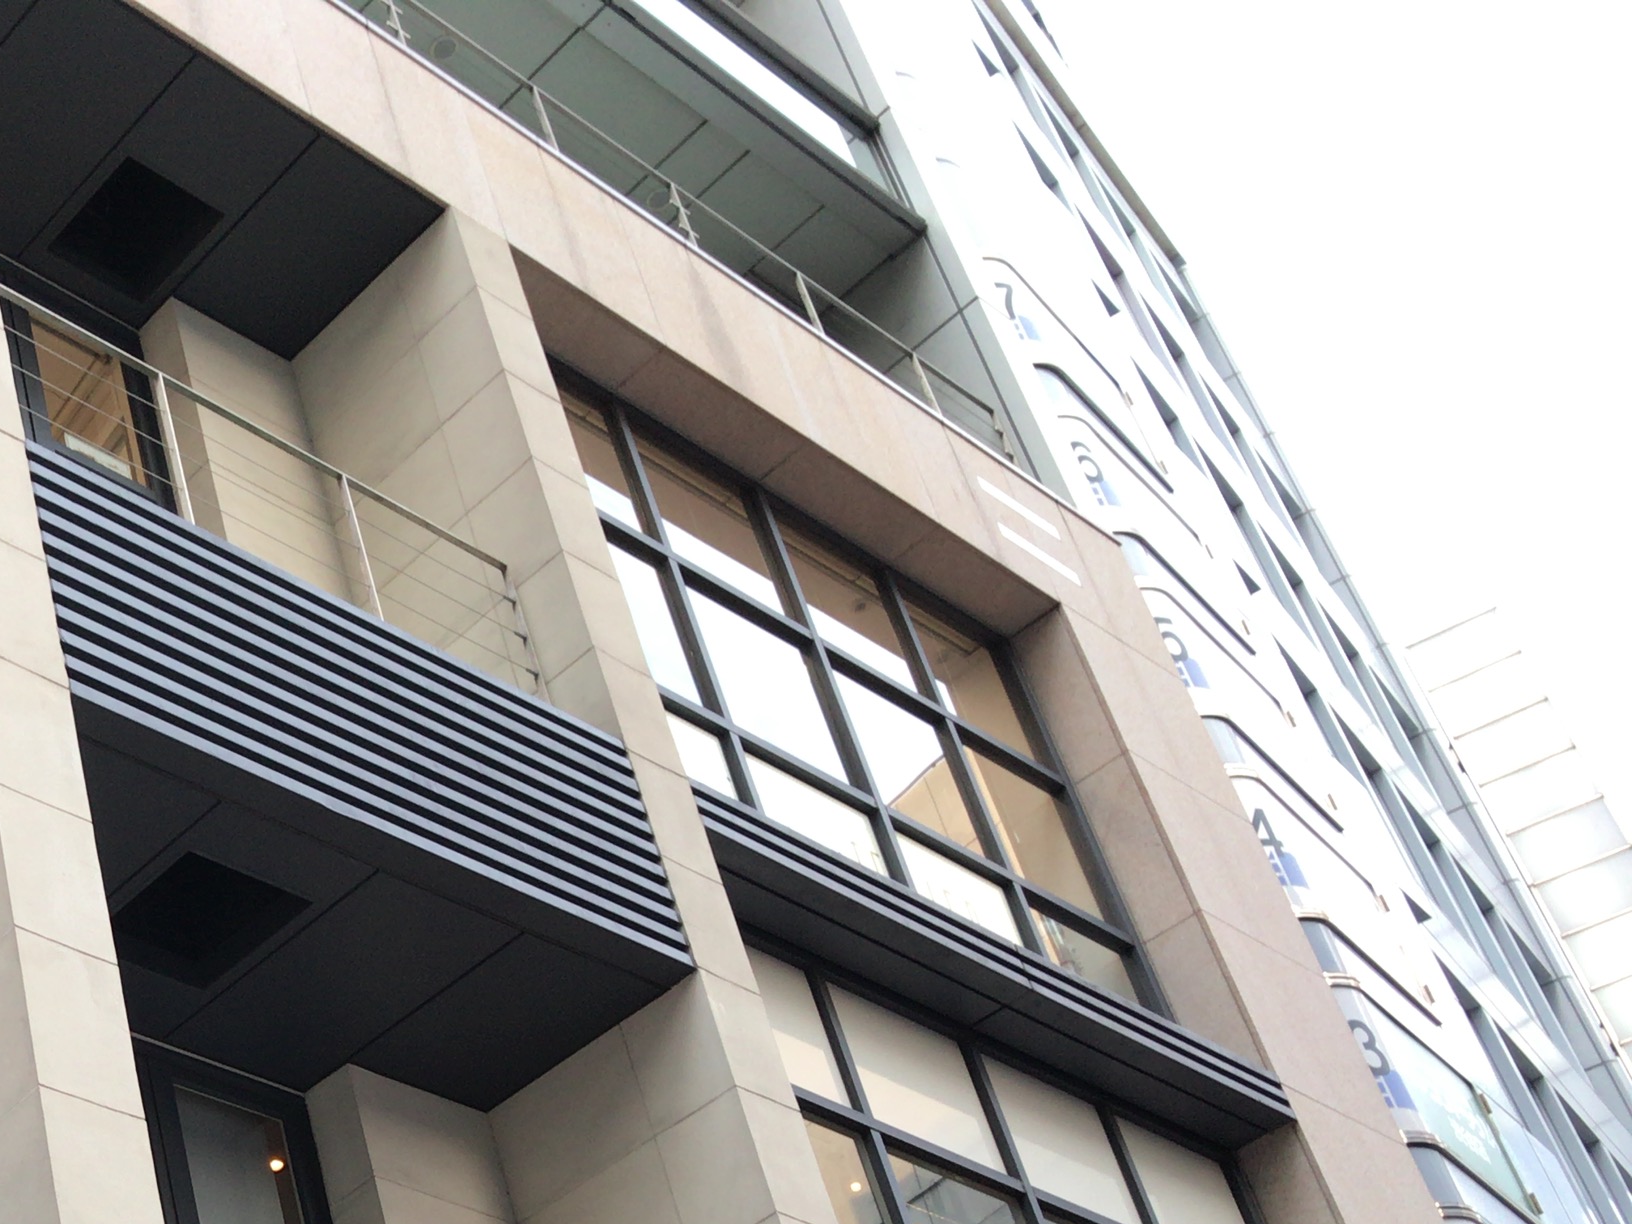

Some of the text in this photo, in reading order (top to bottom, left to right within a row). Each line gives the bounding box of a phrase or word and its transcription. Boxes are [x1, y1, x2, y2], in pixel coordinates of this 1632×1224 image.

[994, 281, 1016, 320] 7
[1251, 807, 1284, 858] 4
[1347, 1018, 1391, 1077] 3
